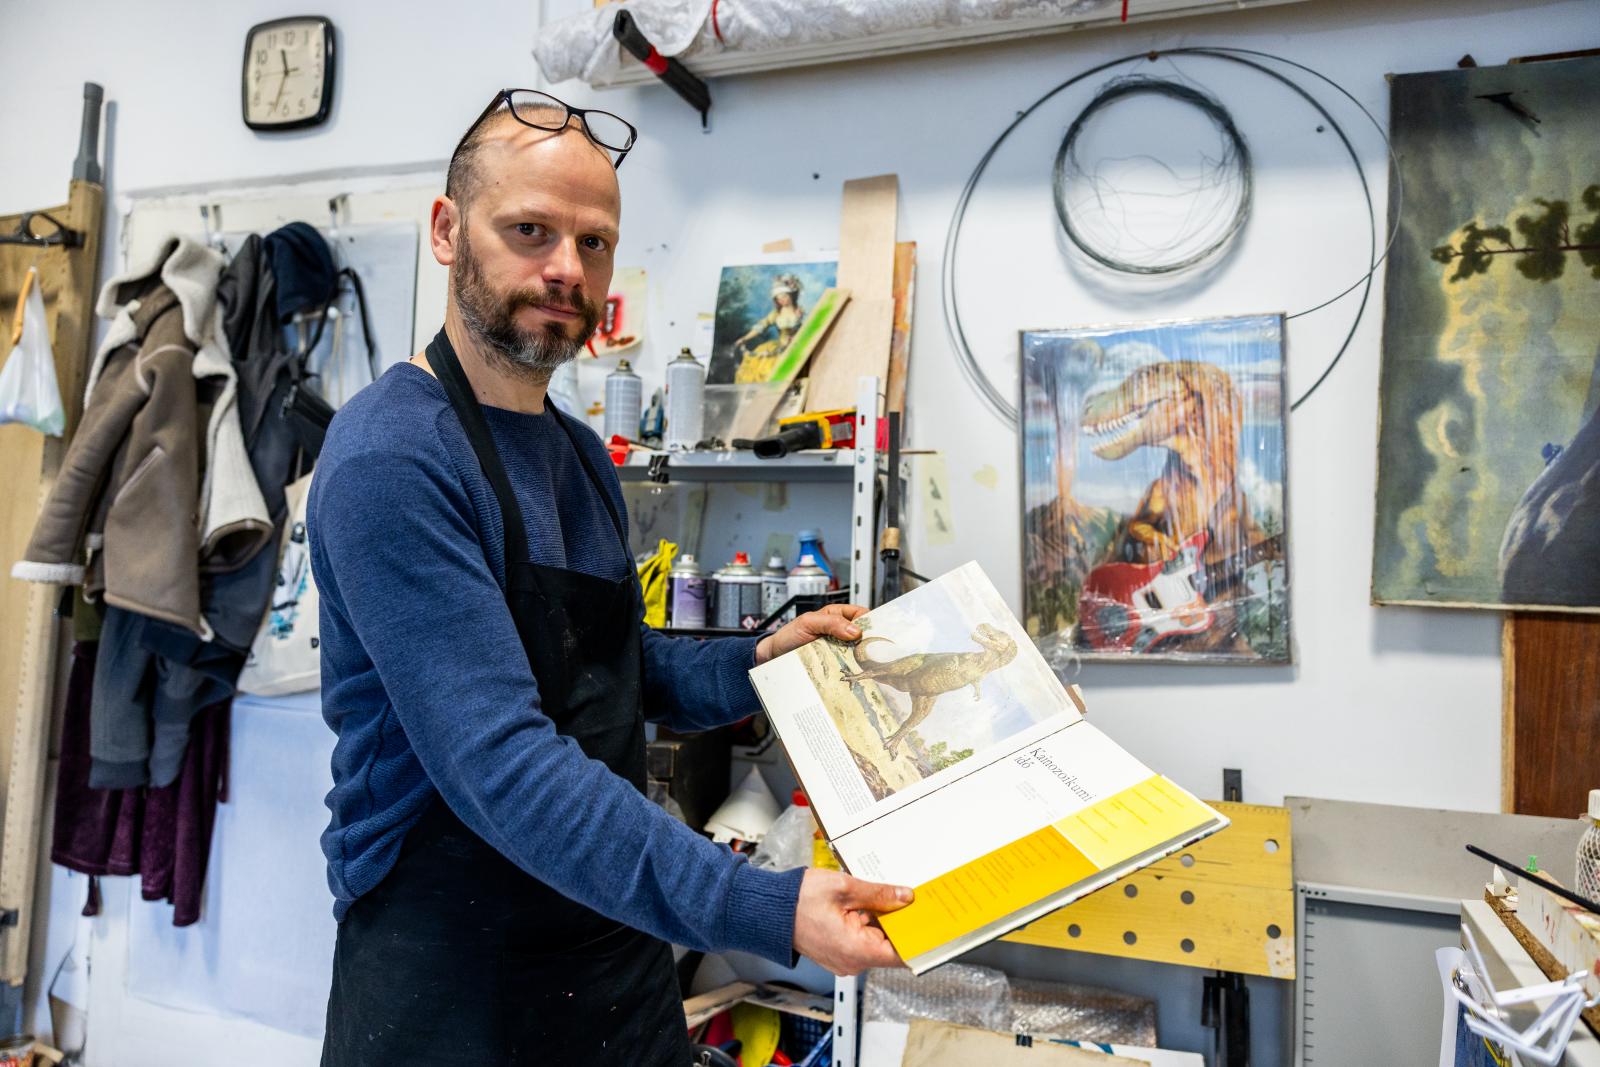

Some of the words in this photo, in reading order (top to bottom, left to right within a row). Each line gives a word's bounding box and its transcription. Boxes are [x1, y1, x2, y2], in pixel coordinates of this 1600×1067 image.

[266, 31, 278, 49] 11
[284, 29, 296, 47] 12
[304, 29, 310, 46] 1
[255, 49, 268, 65] 10
[315, 41, 322, 59] 2
[282, 101, 290, 118] 6
[298, 97, 306, 115] 5
[1029, 747, 1097, 802] Kainozoikumi
